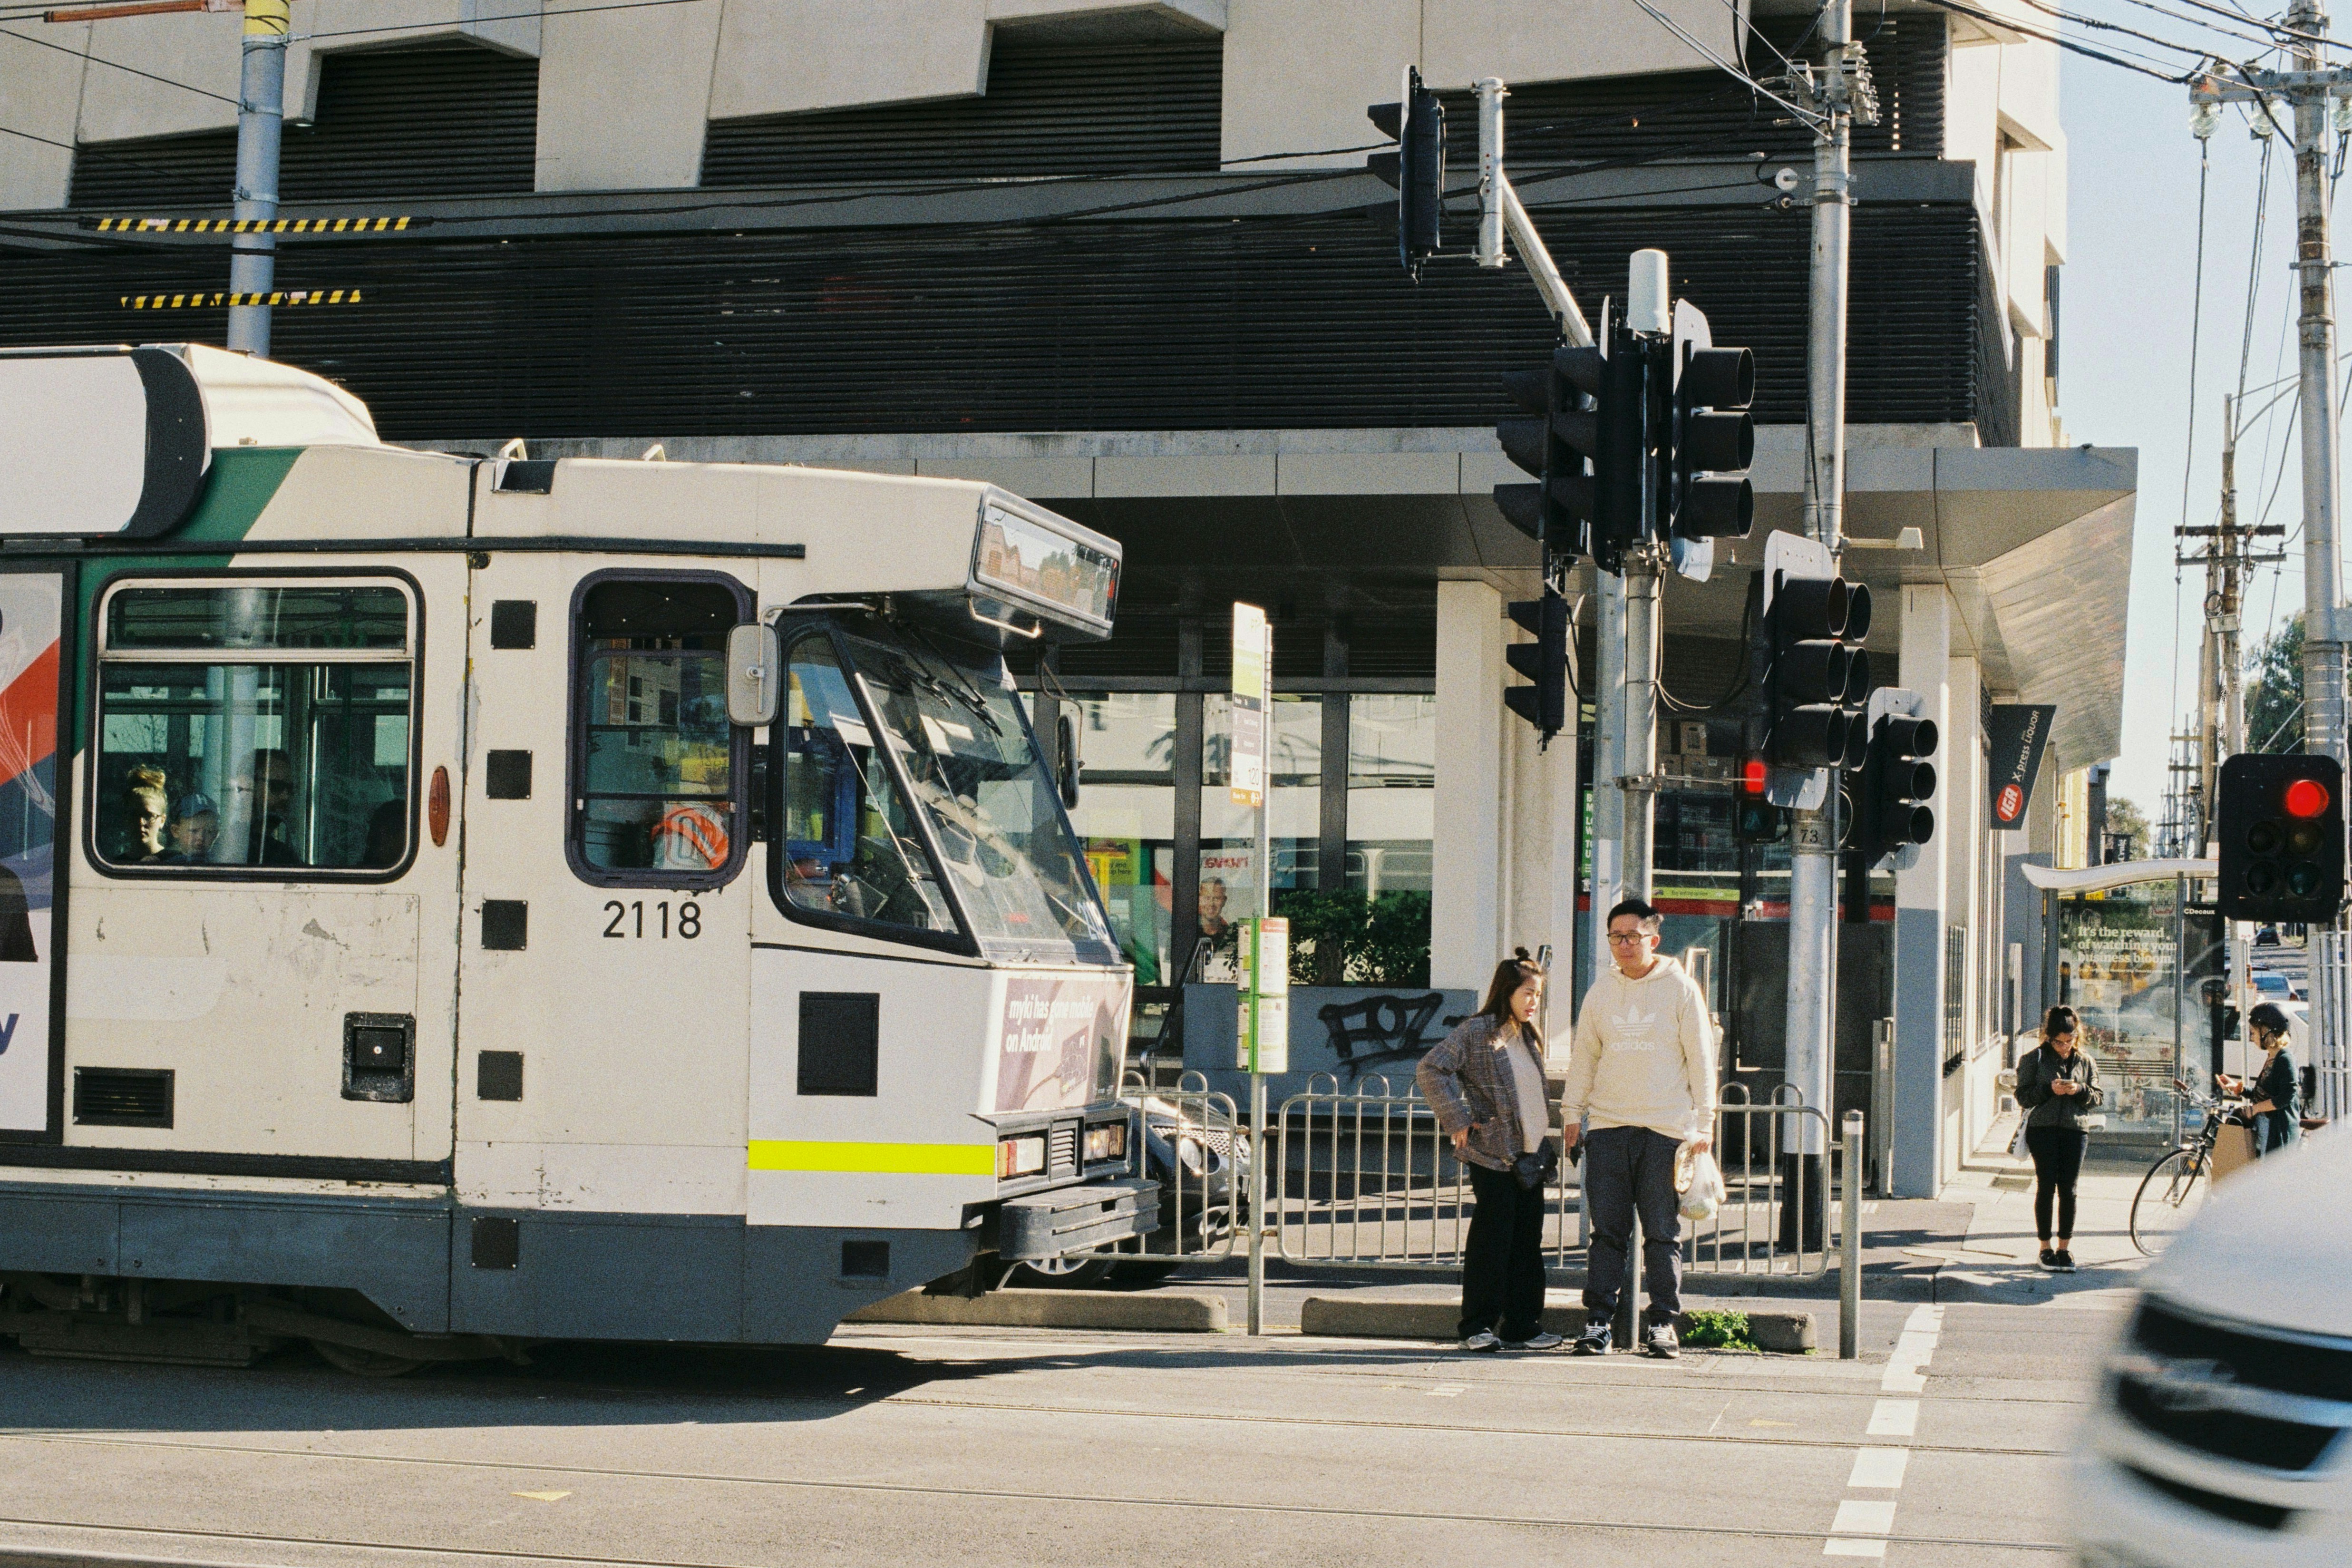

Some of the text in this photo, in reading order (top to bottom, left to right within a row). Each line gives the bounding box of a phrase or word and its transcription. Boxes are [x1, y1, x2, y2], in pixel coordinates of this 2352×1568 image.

[2001, 787, 2018, 818] IGA
[2025, 710, 2040, 743] LIQUOR
[1248, 767, 1260, 786] 120
[1801, 829, 1818, 843] 73
[603, 900, 701, 939] 2118
[2078, 926, 2164, 937] It's the reward
[2078, 940, 2091, 950] of
[2092, 939, 2149, 953] watching
[1009, 993, 1035, 1026] myki
[1033, 994, 1050, 1019] has
[1070, 995, 1094, 1018] mobile
[1006, 1027, 1053, 1053] on Android
[1610, 1039, 1656, 1052] adidas
